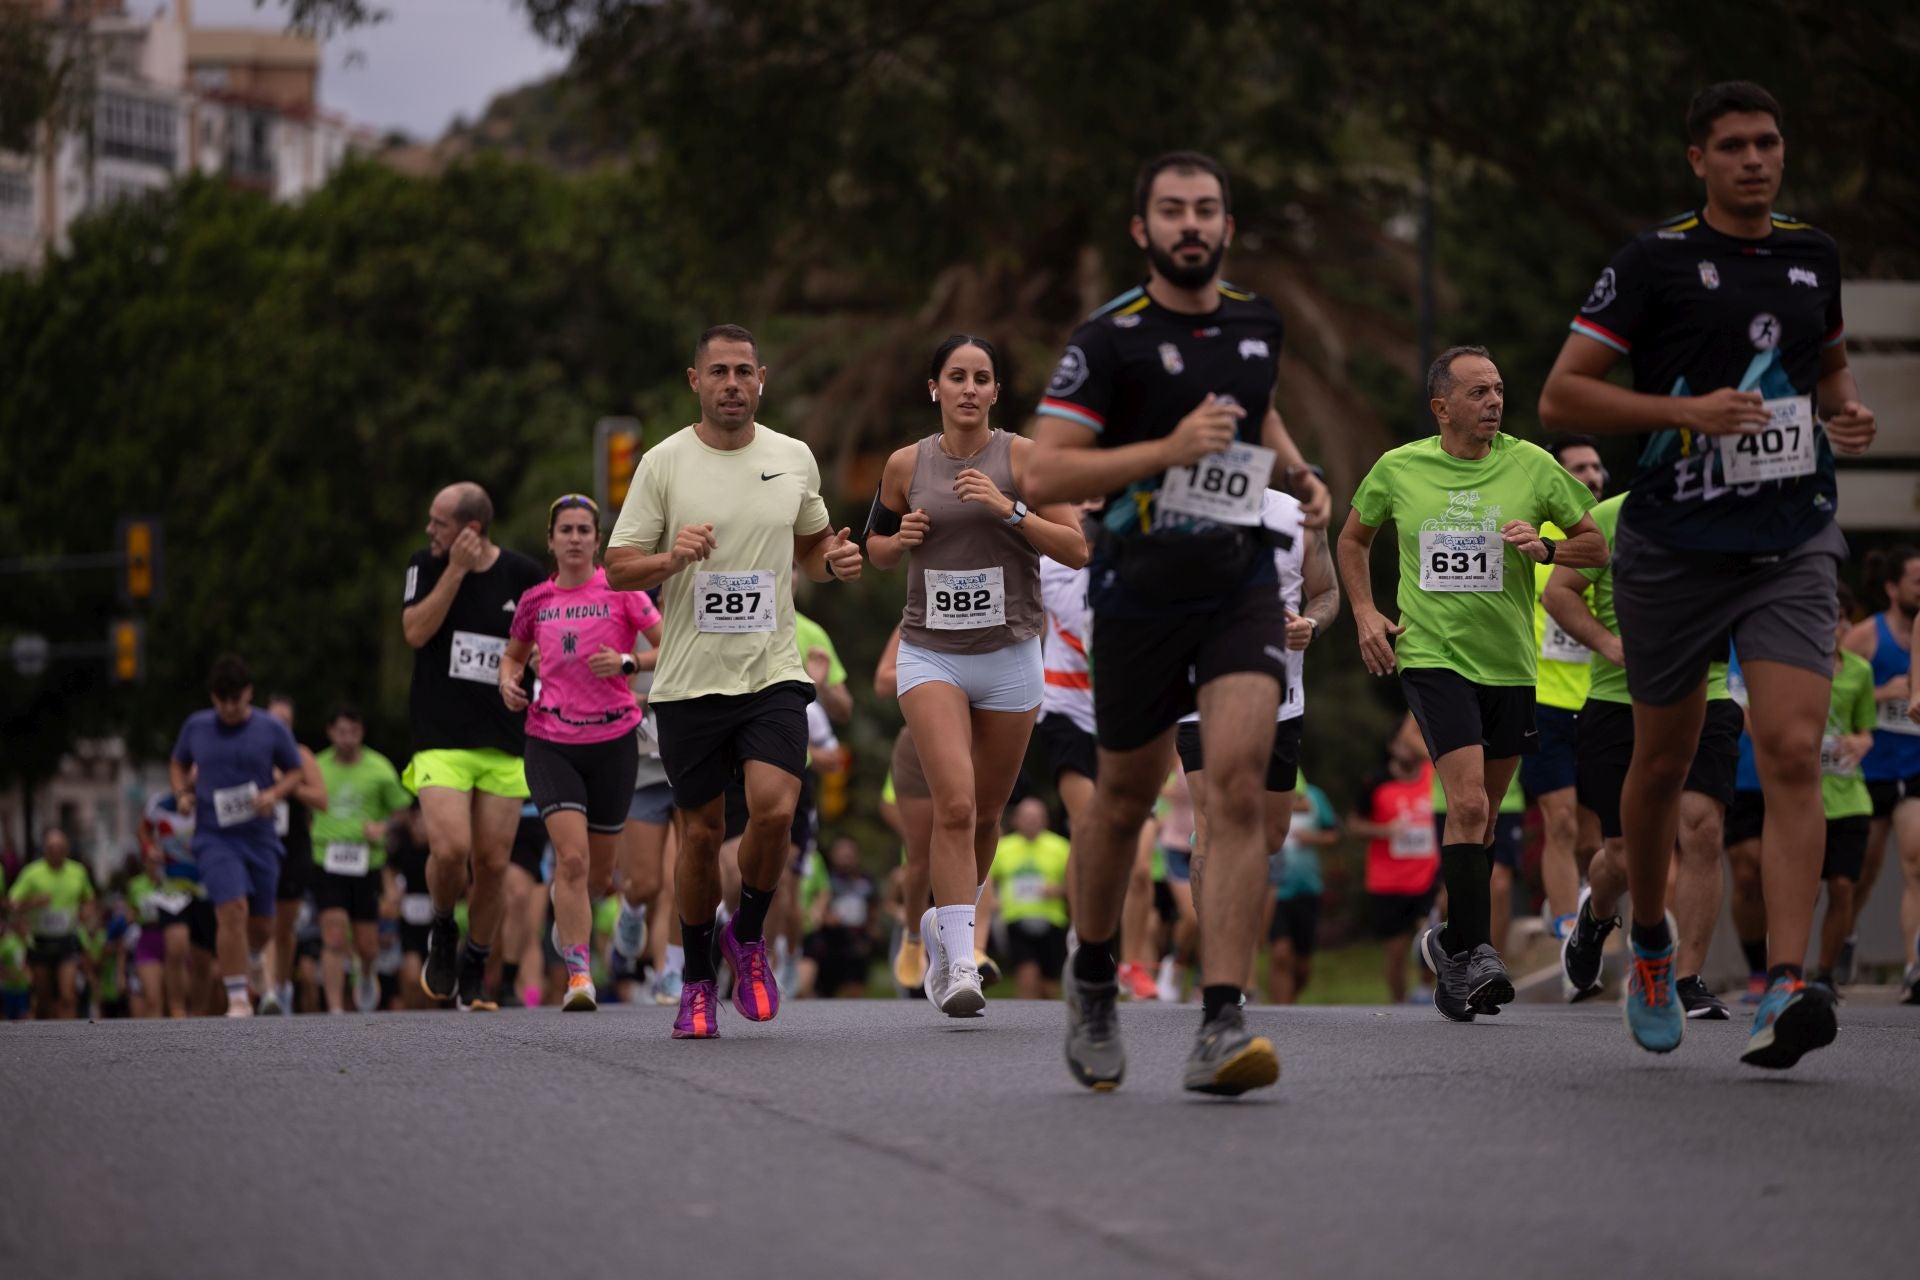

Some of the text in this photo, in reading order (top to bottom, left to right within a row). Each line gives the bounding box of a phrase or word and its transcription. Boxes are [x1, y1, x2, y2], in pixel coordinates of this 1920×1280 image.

[1736, 426, 1801, 456] 407
[1187, 464, 1249, 499] 180
[1432, 552, 1487, 573] 631
[565, 603, 609, 619] MEDULA
[705, 592, 761, 614] 287
[935, 590, 991, 611] 982
